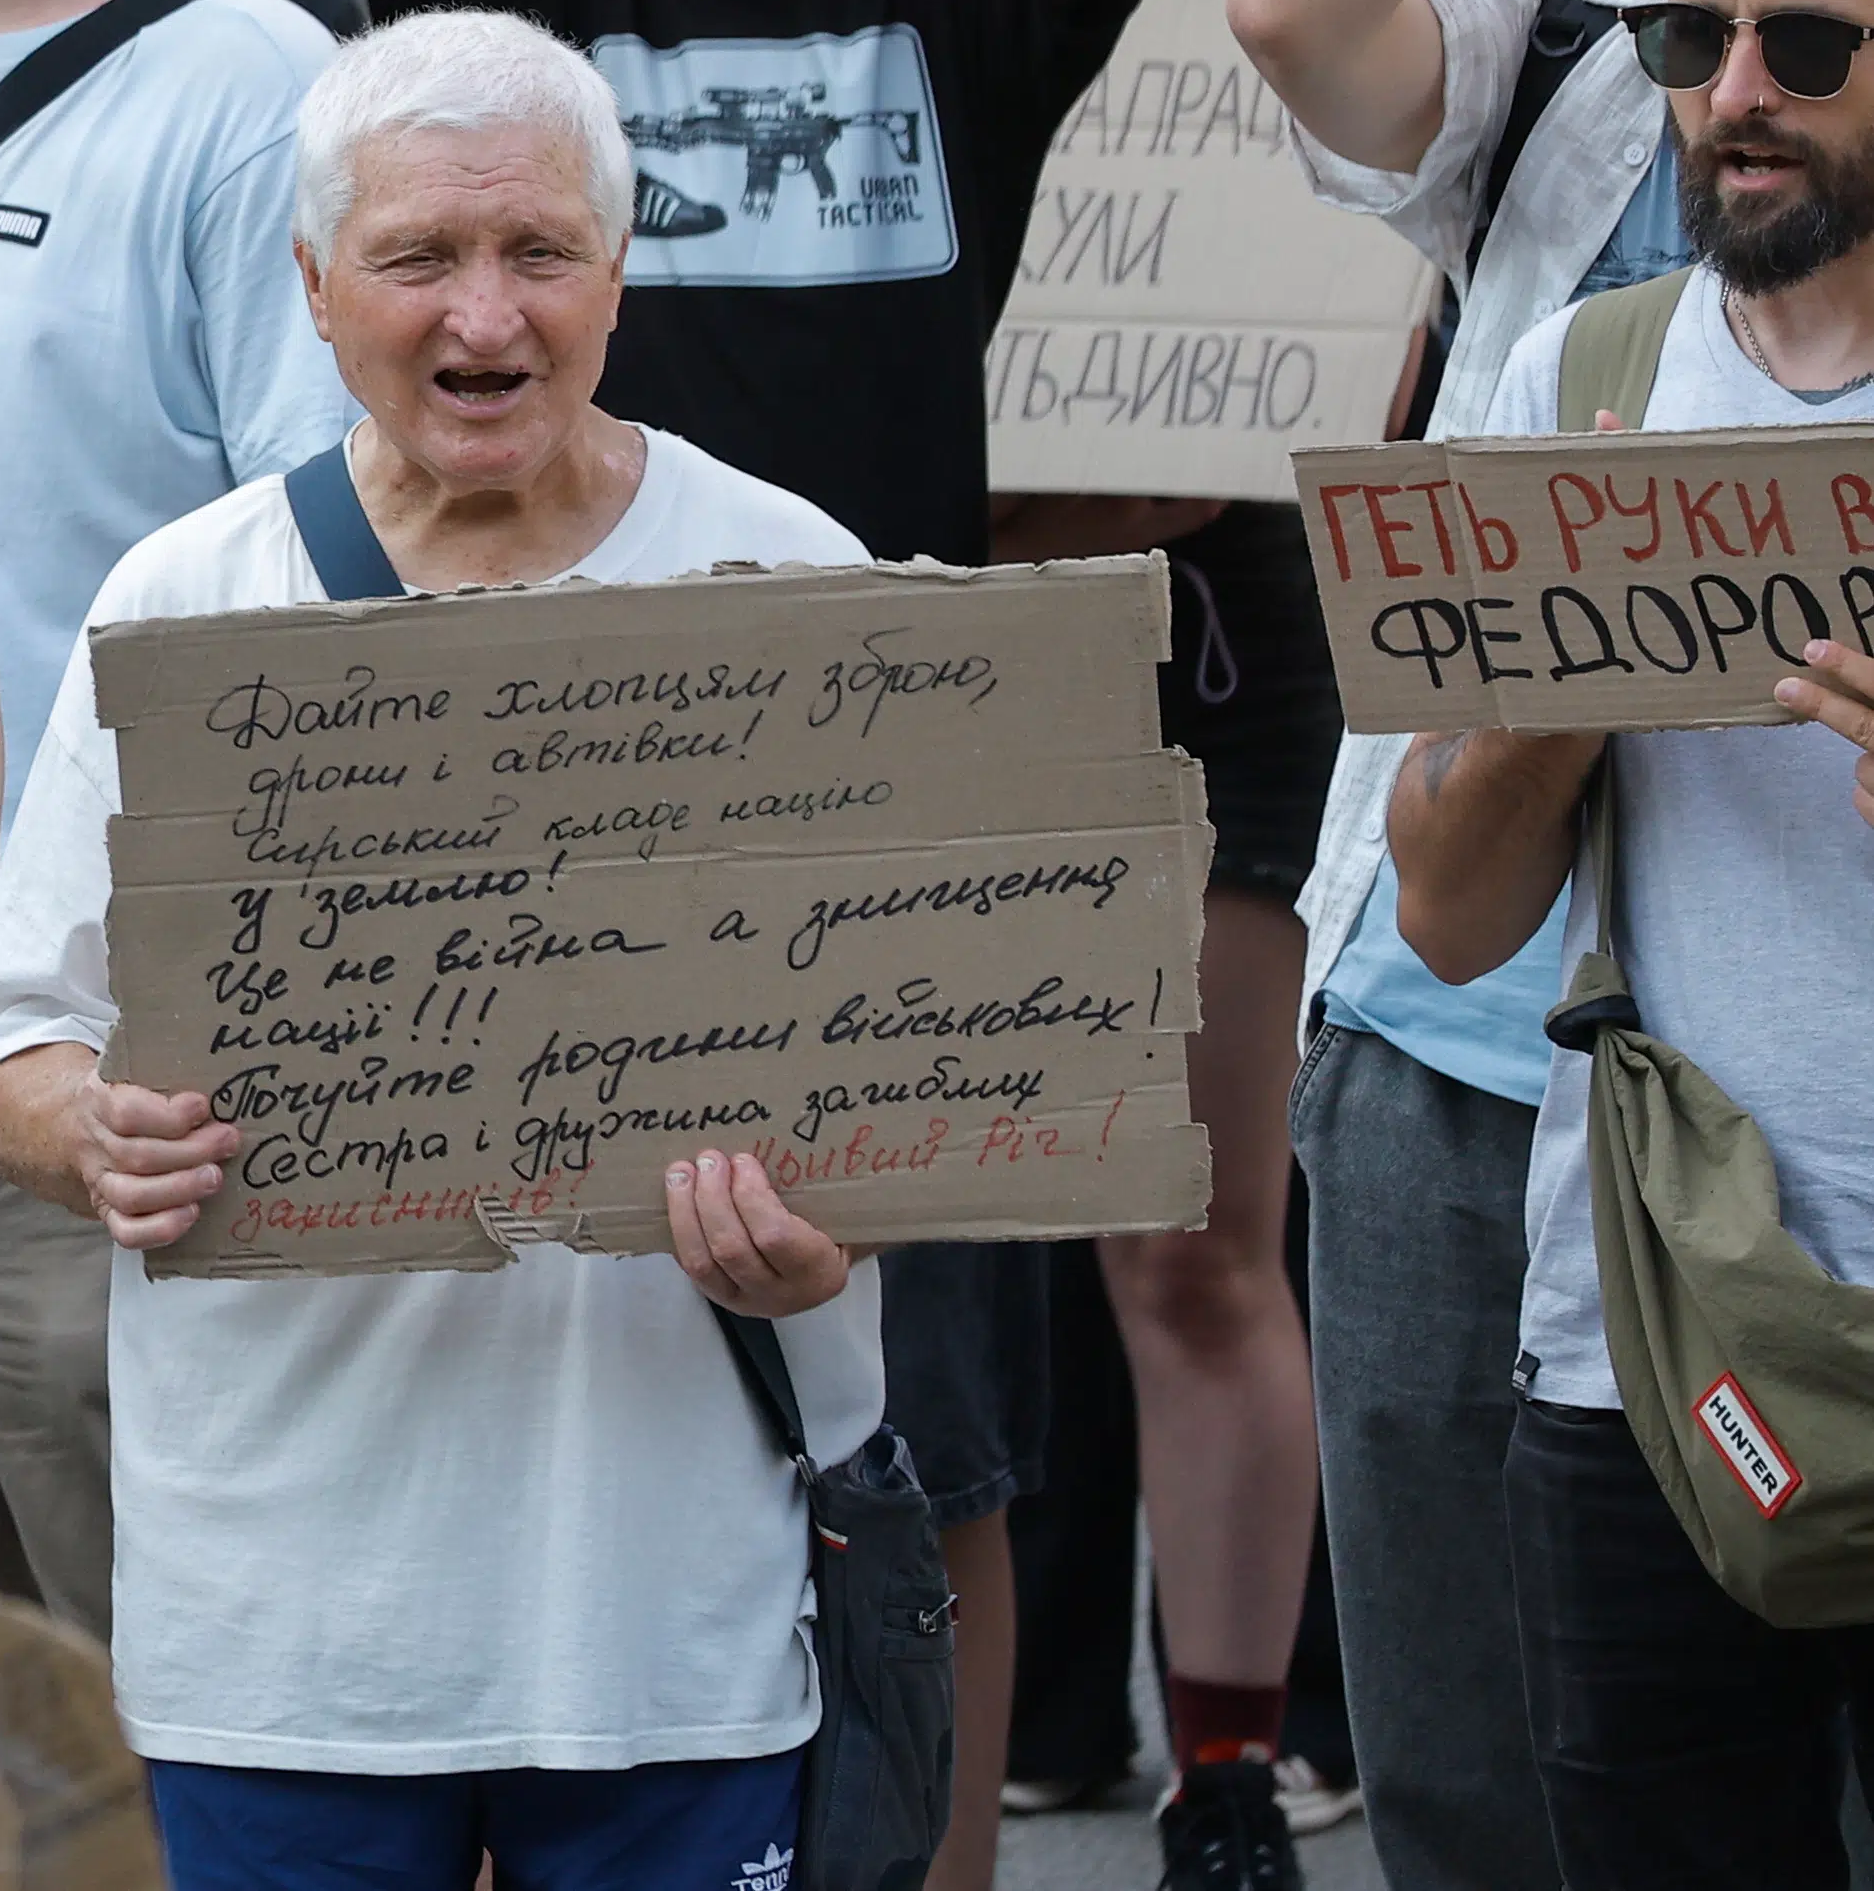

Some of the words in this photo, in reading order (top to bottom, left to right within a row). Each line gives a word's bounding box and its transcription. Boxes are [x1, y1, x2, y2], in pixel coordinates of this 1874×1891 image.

[1318, 478, 1520, 584] ГЕТЬ
[1546, 471, 1799, 575] РУКИ
[204, 664, 451, 750] Дайте
[483, 664, 787, 720] хлопцям
[232, 754, 405, 837] дрони
[431, 752, 454, 784] і
[244, 793, 520, 879] Сирський
[543, 799, 692, 864] кладе
[719, 775, 894, 824] націю
[205, 960, 290, 1016] Це
[322, 951, 396, 991] не
[435, 914, 667, 977] війна
[709, 909, 759, 944] а
[786, 855, 1130, 972] знищення
[209, 1055, 476, 1145] Почуйте
[517, 1018, 797, 1107] родини
[241, 1130, 449, 1191] Сестра
[474, 1119, 491, 1153] і
[510, 1099, 772, 1183] дружина
[792, 1055, 1045, 1143] загиблих
[1708, 1394, 1779, 1496] HUNTER
